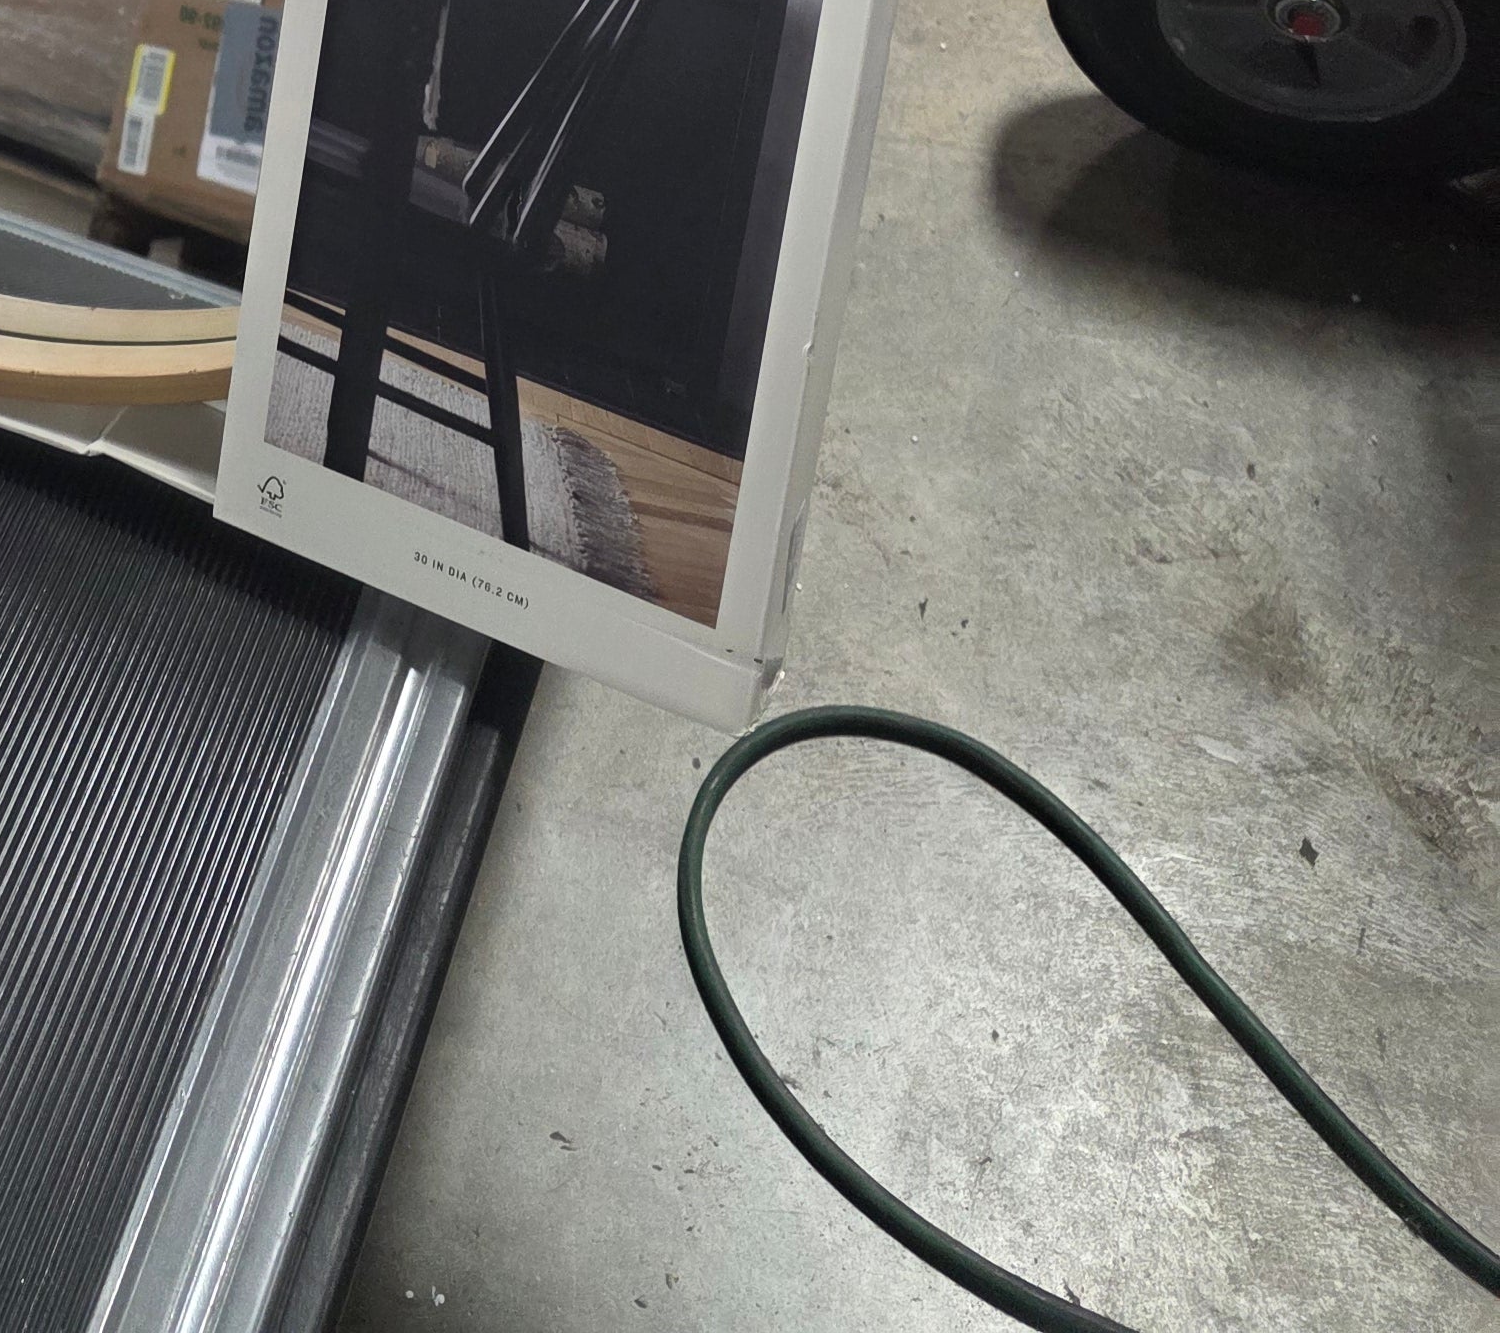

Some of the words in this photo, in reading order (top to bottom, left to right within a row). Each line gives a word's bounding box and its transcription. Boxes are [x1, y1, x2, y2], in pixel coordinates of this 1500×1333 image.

[412, 550, 429, 566] 30
[431, 559, 445, 573] IN
[448, 565, 468, 583] DIA
[505, 590, 530, 611] CM)
